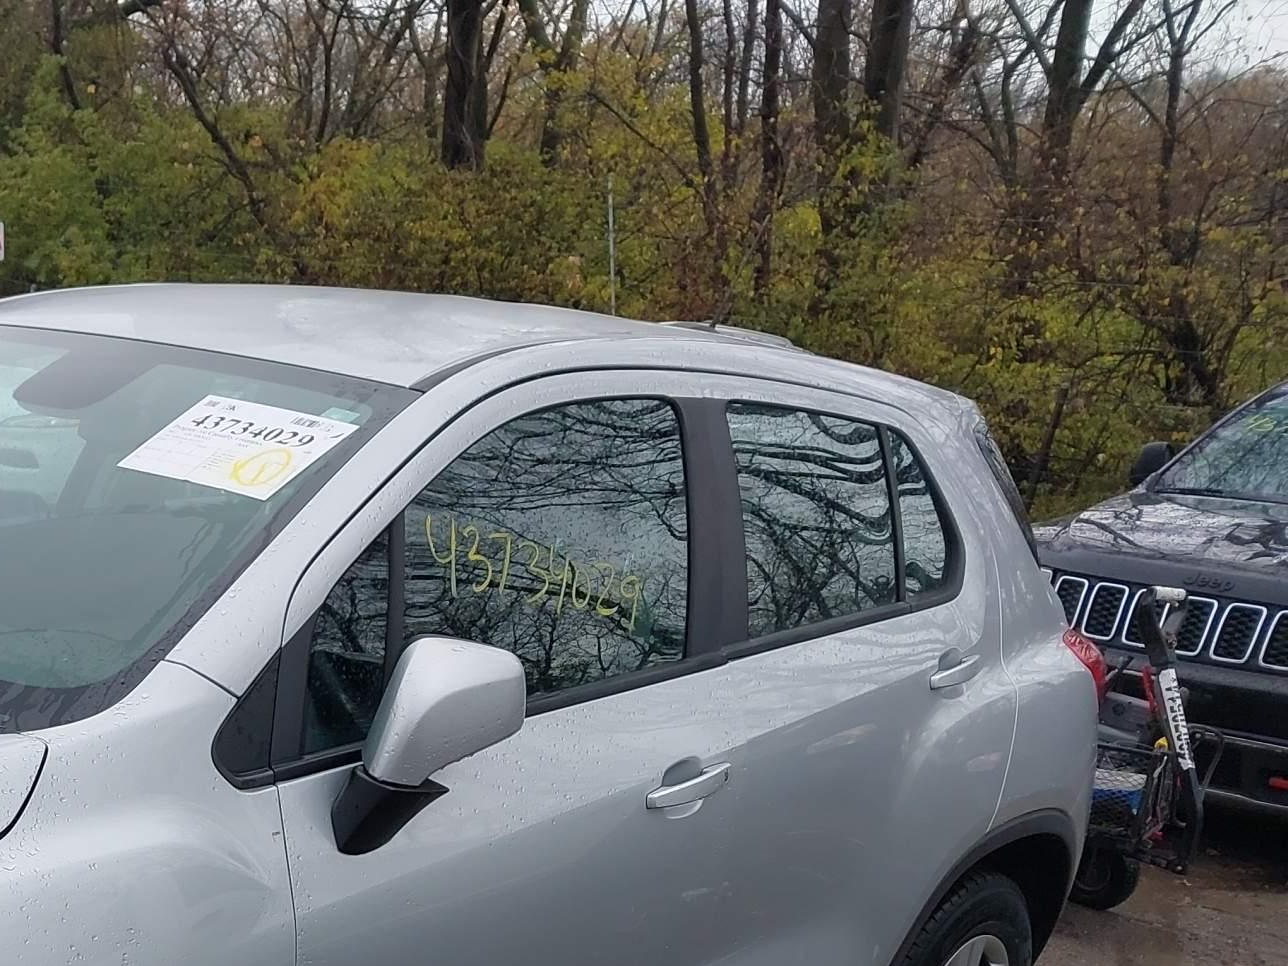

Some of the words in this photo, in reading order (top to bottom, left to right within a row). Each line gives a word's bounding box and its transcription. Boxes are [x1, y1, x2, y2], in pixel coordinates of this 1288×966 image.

[192, 413, 316, 448] 43734029
[425, 514, 643, 635] 43734029
[1183, 572, 1236, 593] Jeep
